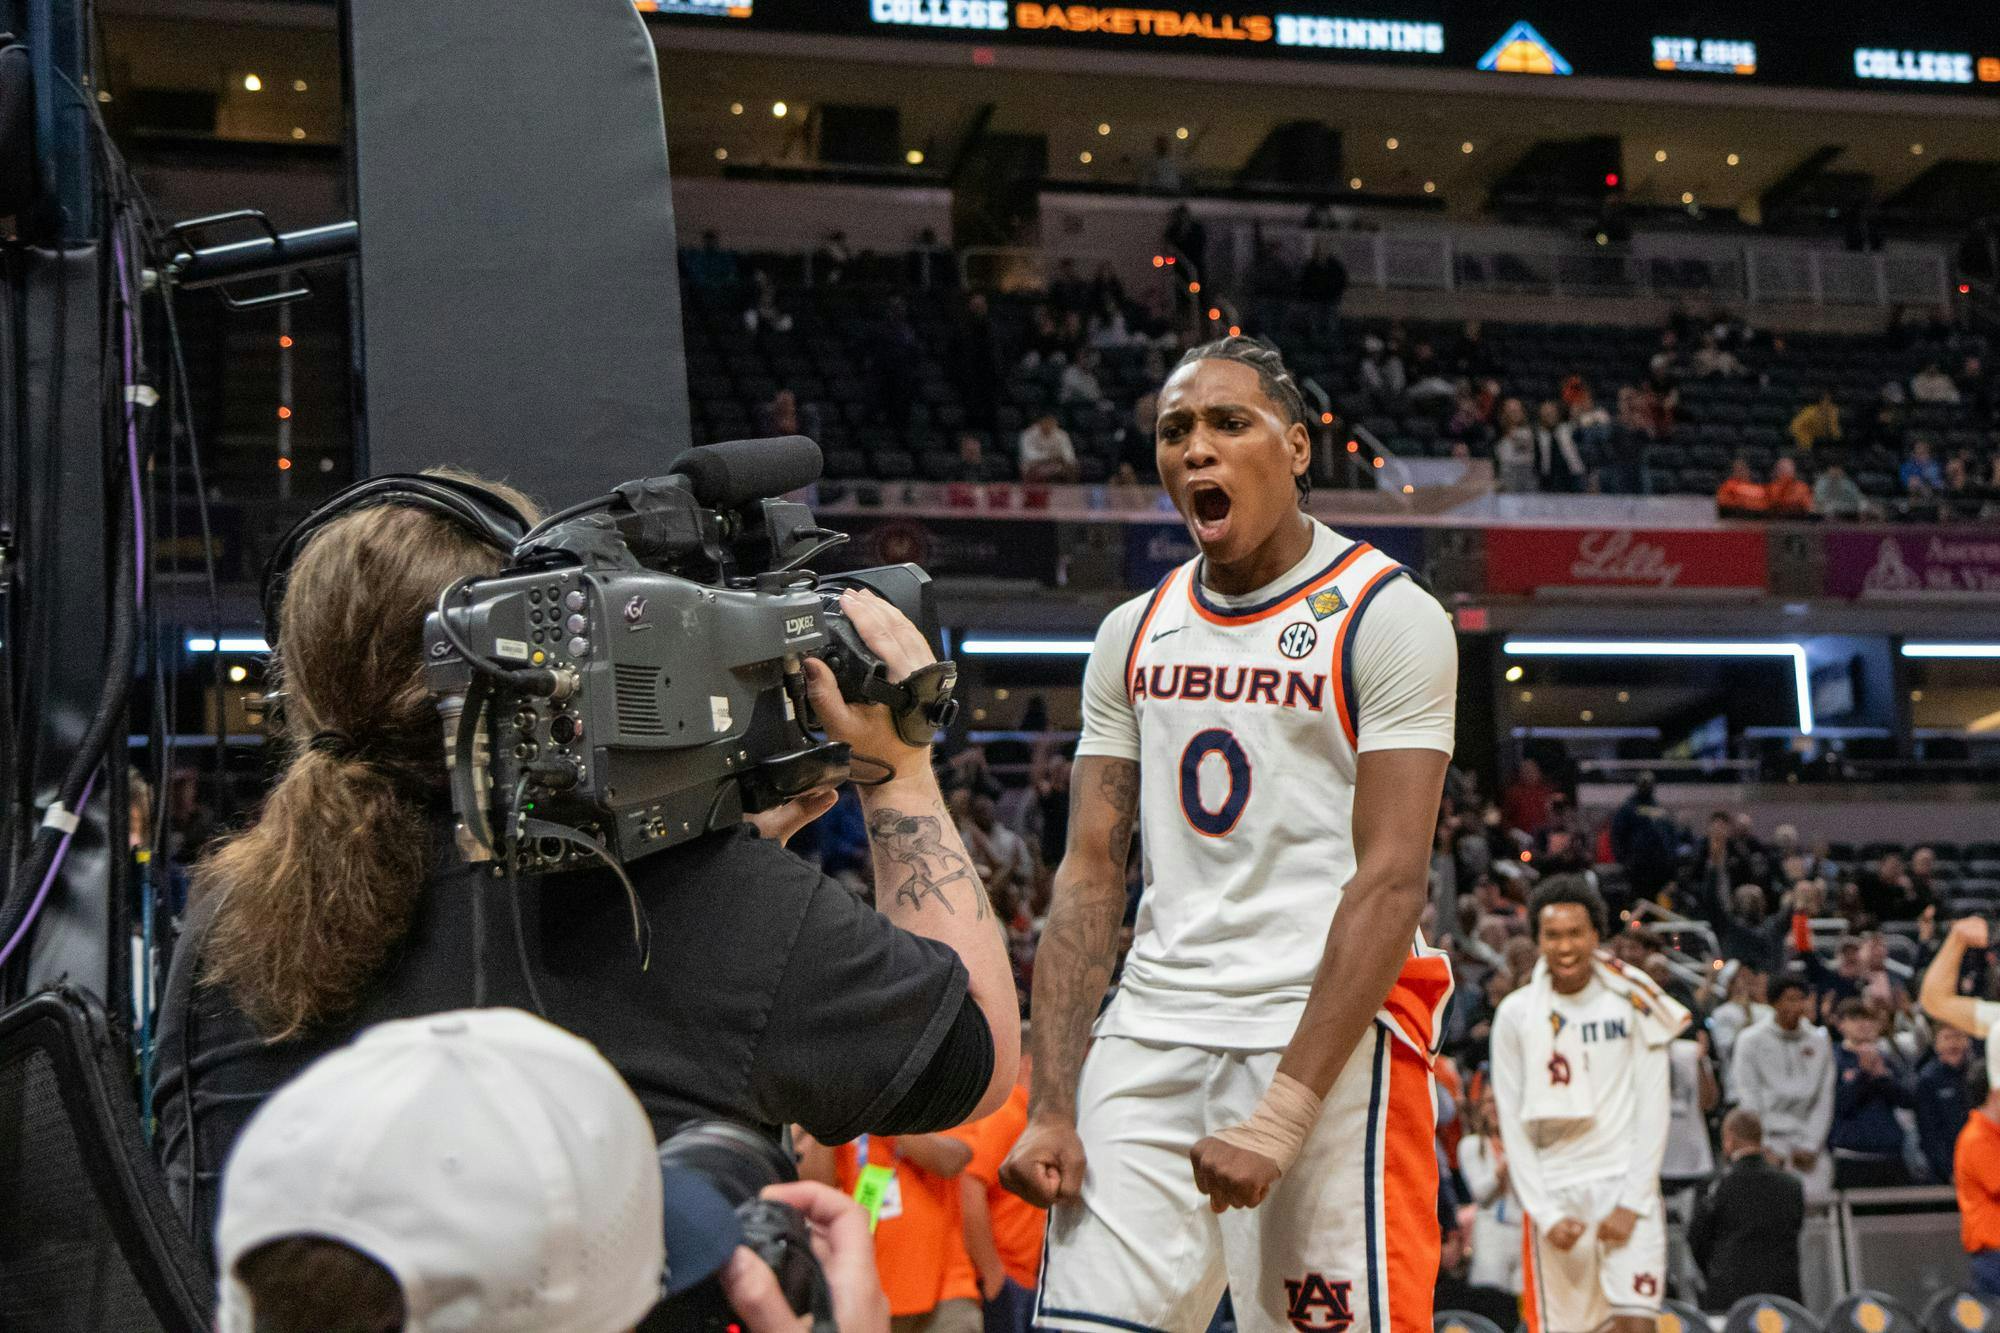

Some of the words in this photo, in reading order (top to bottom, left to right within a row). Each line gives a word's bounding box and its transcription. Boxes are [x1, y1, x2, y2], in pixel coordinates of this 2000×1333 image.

[871, 0, 1009, 31] COLLEGE
[1275, 14, 1444, 54] BEGINNING
[1853, 47, 1974, 83] COLLEGE
[1279, 622, 1316, 659] SEC
[1132, 665, 1327, 712] AUBURN
[1179, 727, 1253, 838] 0
